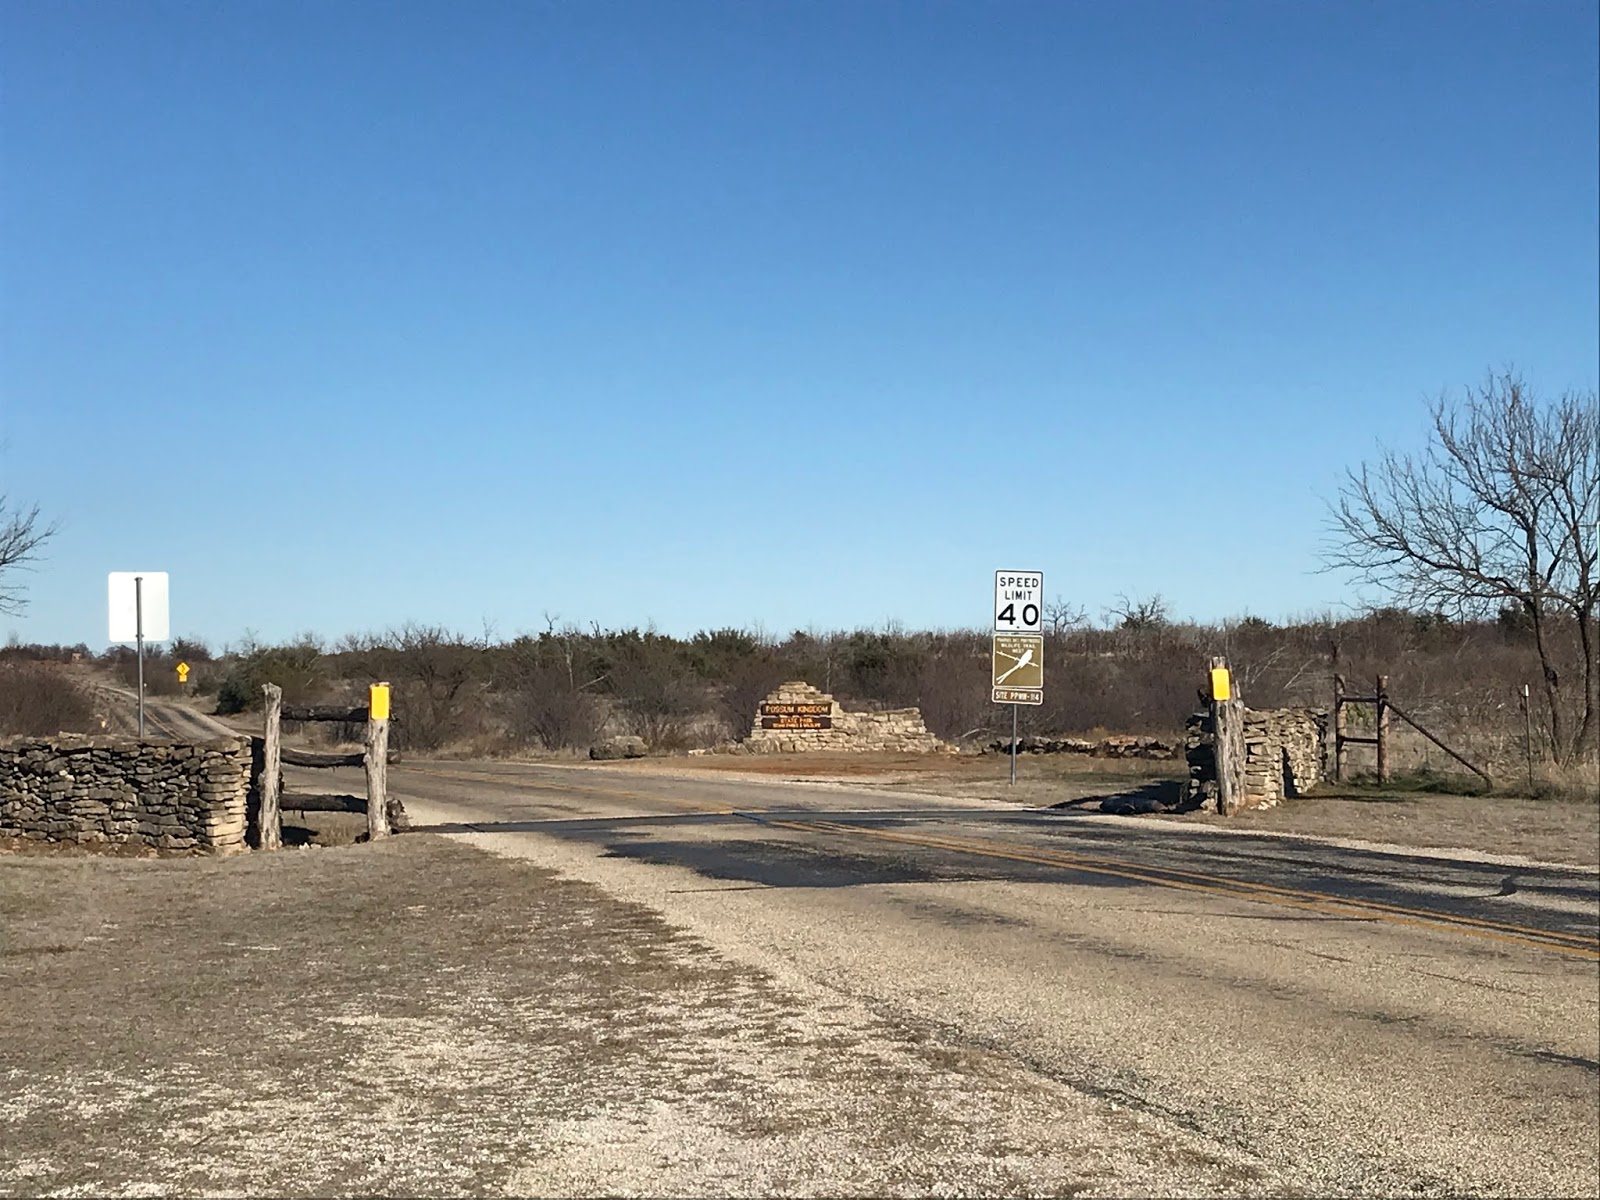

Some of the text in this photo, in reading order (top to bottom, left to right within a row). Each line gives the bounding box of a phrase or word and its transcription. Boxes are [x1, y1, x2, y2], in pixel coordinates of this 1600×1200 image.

[1000, 577, 1039, 588] SPEED
[1005, 590, 1032, 601] LIMIT
[998, 603, 1039, 626] 40
[995, 691, 1008, 700] SITE
[766, 705, 828, 713] POSSUM KINGDOM
